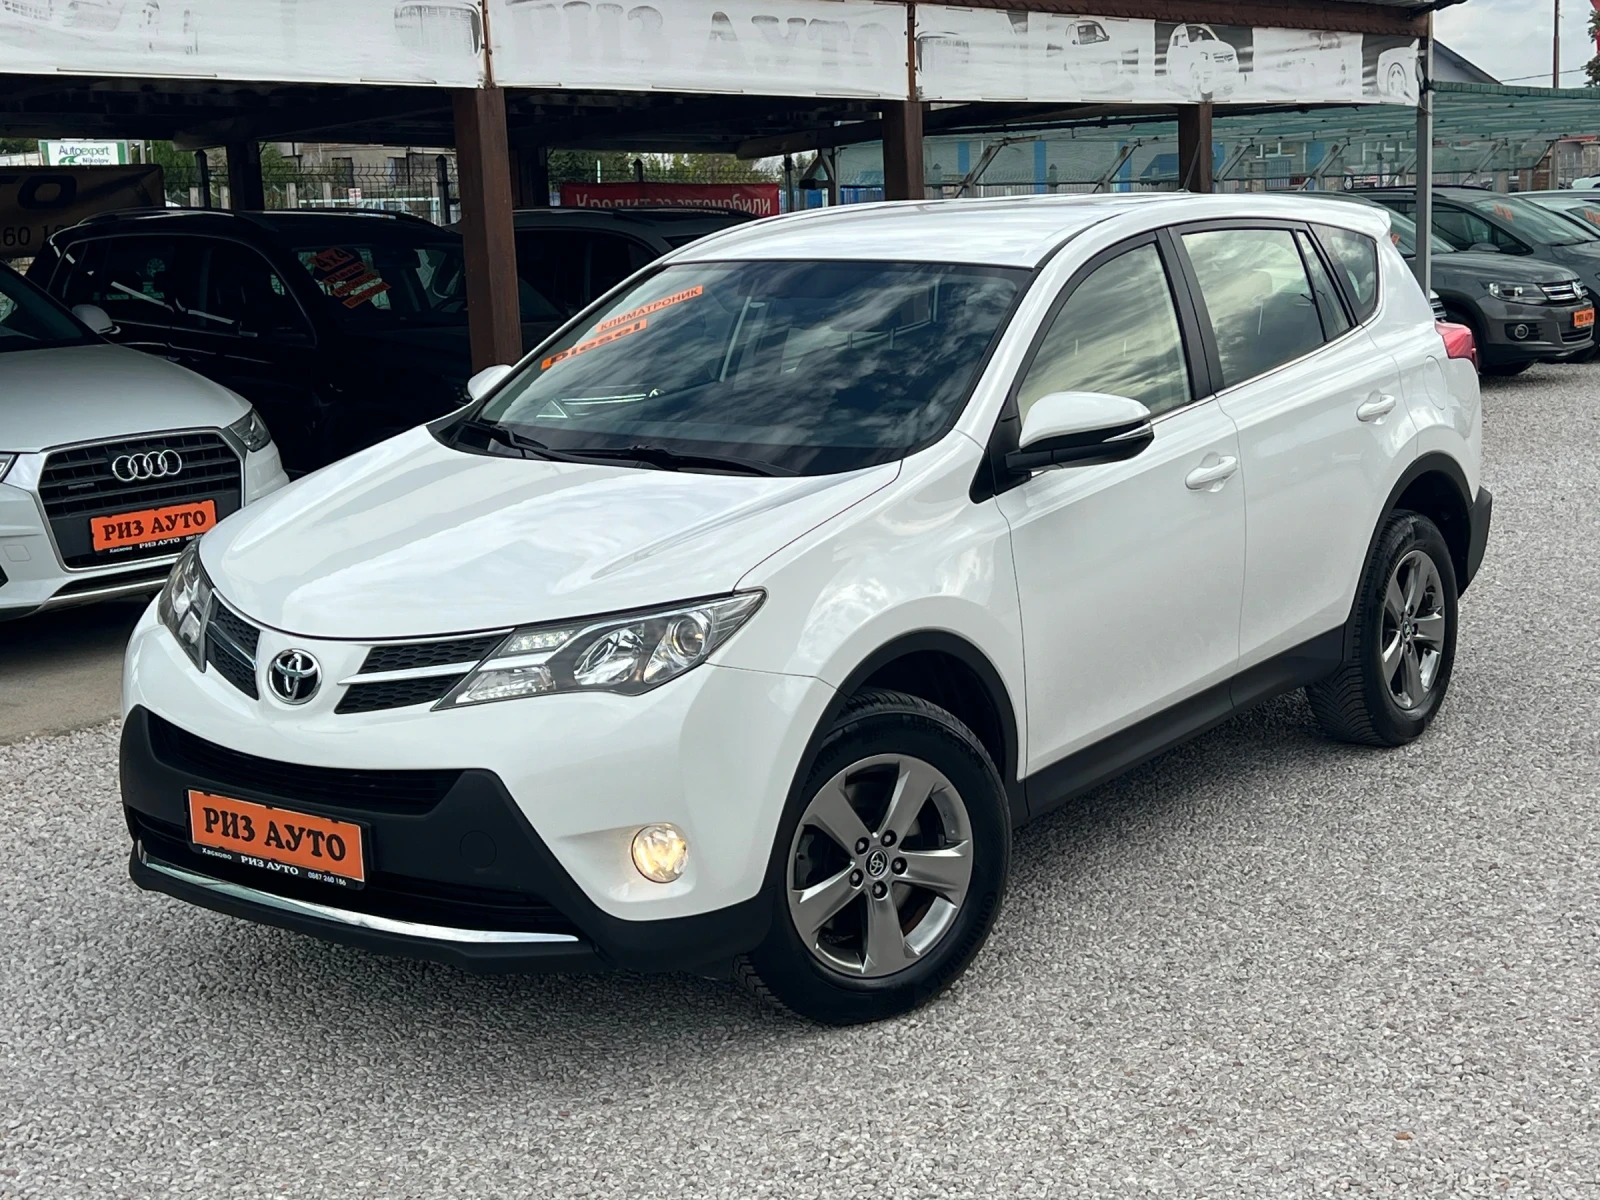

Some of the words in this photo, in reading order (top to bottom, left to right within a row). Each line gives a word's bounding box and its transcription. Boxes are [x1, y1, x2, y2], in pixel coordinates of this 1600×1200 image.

[59, 145, 110, 157] Autoexpert
[600, 288, 700, 331] КЛИМАТРОНИК
[550, 322, 641, 364] Diesel
[103, 519, 144, 541] РИЗ
[151, 510, 206, 535] АУТО
[158, 537, 180, 546] АУТО
[202, 807, 256, 842] РИЗ
[264, 820, 346, 861] АУТО
[202, 847, 232, 860] Хасково
[240, 855, 264, 868] РИЗ
[266, 862, 299, 875] АУТО
